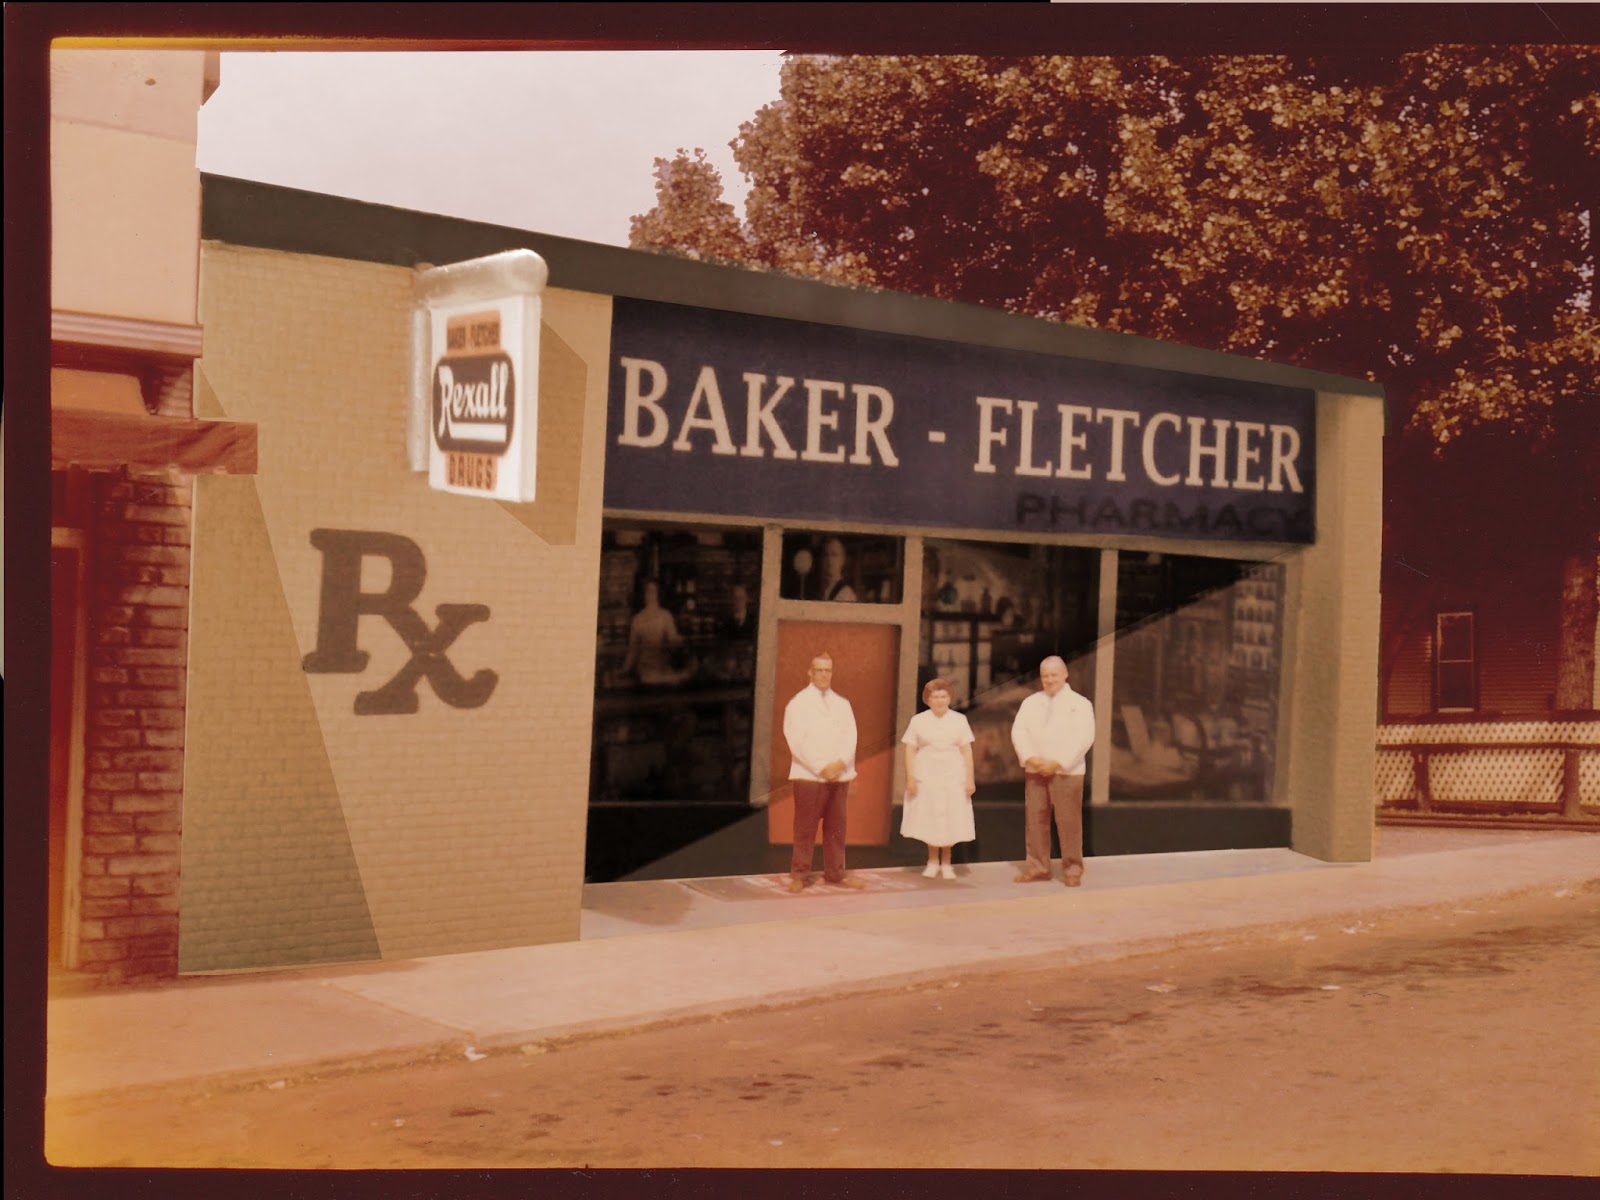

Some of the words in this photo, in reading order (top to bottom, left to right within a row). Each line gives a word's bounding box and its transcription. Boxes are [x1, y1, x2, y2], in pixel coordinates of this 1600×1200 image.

[438, 361, 509, 439] Rexall
[618, 356, 899, 466] BAKER
[973, 396, 1304, 494] FLETCHER
[449, 453, 494, 490] DRUGS
[302, 528, 499, 716] Rx
